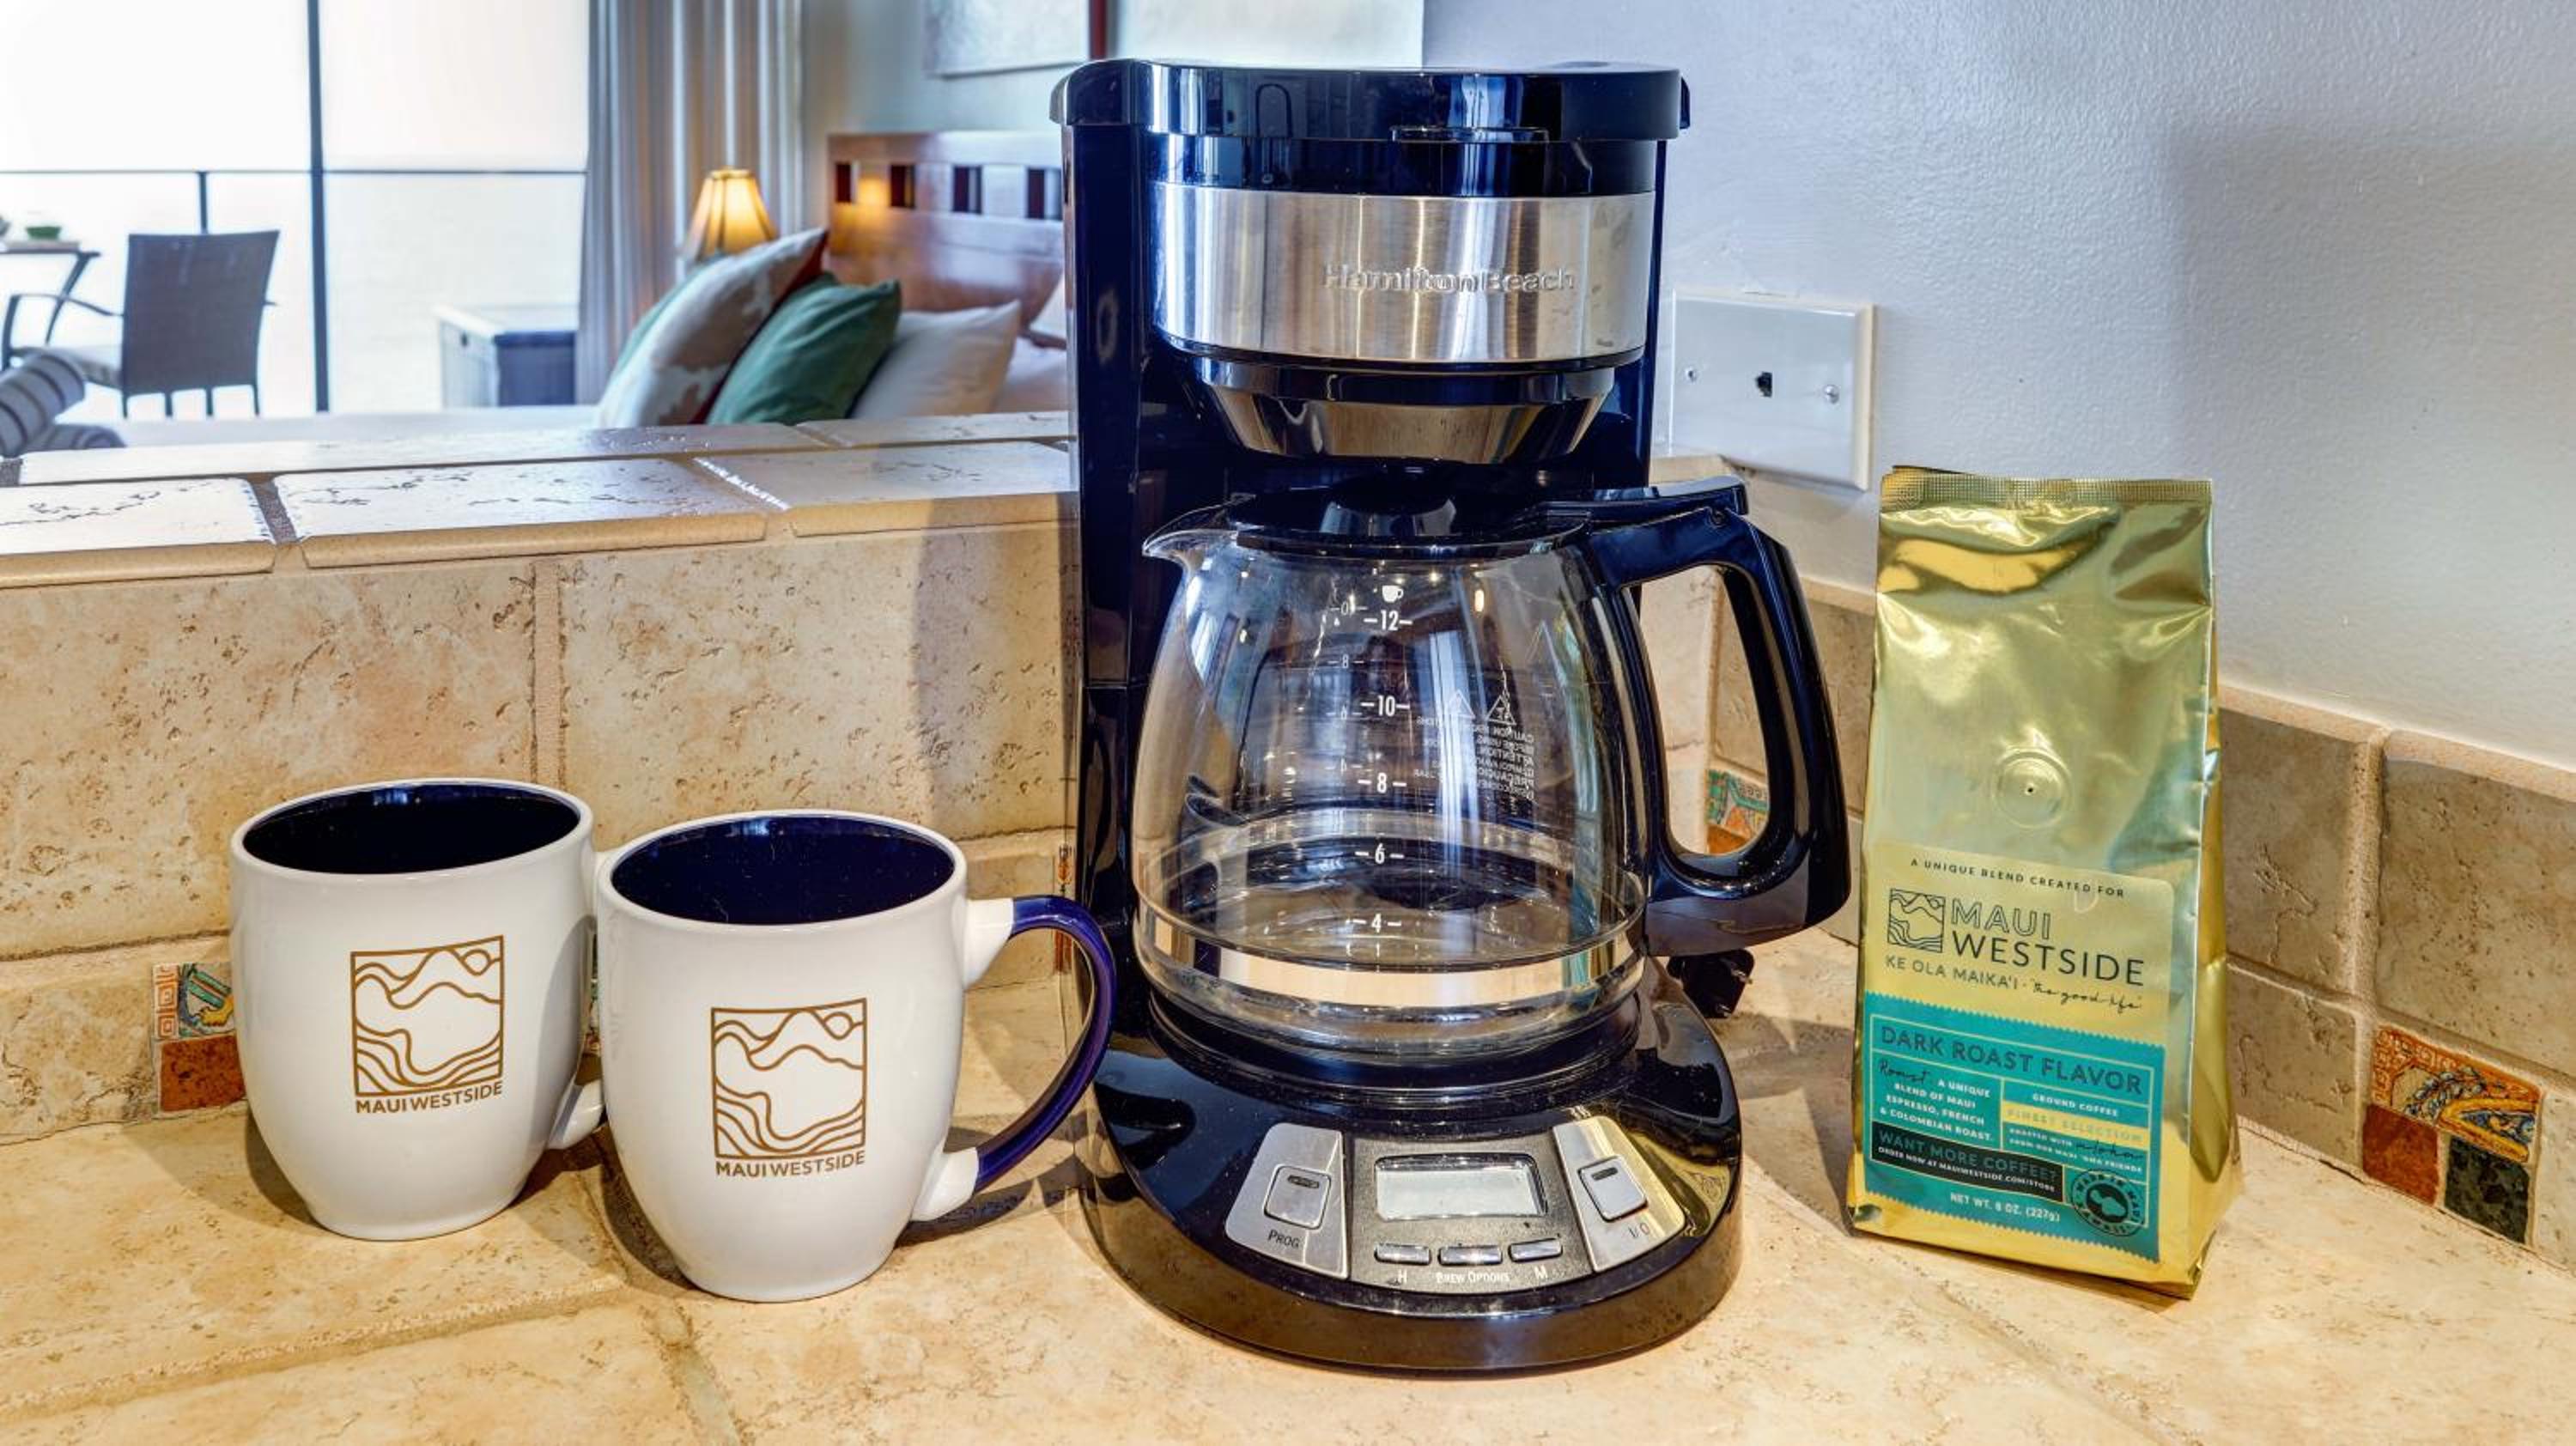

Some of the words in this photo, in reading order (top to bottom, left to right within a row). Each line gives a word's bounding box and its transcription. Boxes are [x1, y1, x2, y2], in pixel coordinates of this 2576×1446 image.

[1924, 860, 1976, 875] UNIQUE
[1981, 868, 2024, 883] BLEND
[2029, 876, 2091, 893] CREATED
[2098, 884, 2123, 898] FOR
[1950, 898, 2051, 941] MAUI
[1886, 954, 1906, 969] KE
[1912, 959, 1947, 978] OLA
[1952, 930, 2144, 987] WESTSIDE
[1881, 1026, 1943, 1056] DARK
[1952, 1040, 2034, 1072] ROAST
[2041, 1056, 2142, 1095] FLAVOR
[1894, 1082, 1928, 1098] BLEND
[1929, 1091, 1944, 1102] OF
[1947, 1095, 1976, 1109] MAUI
[1938, 1078, 1945, 1088] A
[1948, 1080, 1990, 1098] UNIQUE
[2032, 1092, 2076, 1109] GROUND
[2079, 1099, 2118, 1117] COFFEE
[1890, 1109, 1952, 1132] COLOMBIAN
[1942, 1108, 1985, 1126] FRENCH
[1878, 1129, 1926, 1152] WANT
[1931, 1145, 1978, 1167] MORE
[1984, 1157, 2057, 1182] COFFEE?
[1878, 1145, 1905, 1159] ORDER
[1905, 1152, 1927, 1165] NOW
[1927, 1158, 1937, 1168] AT
[1950, 1191, 1970, 1204] NET
[1398, 1268, 1407, 1283] H
[1534, 1267, 1549, 1279] M
